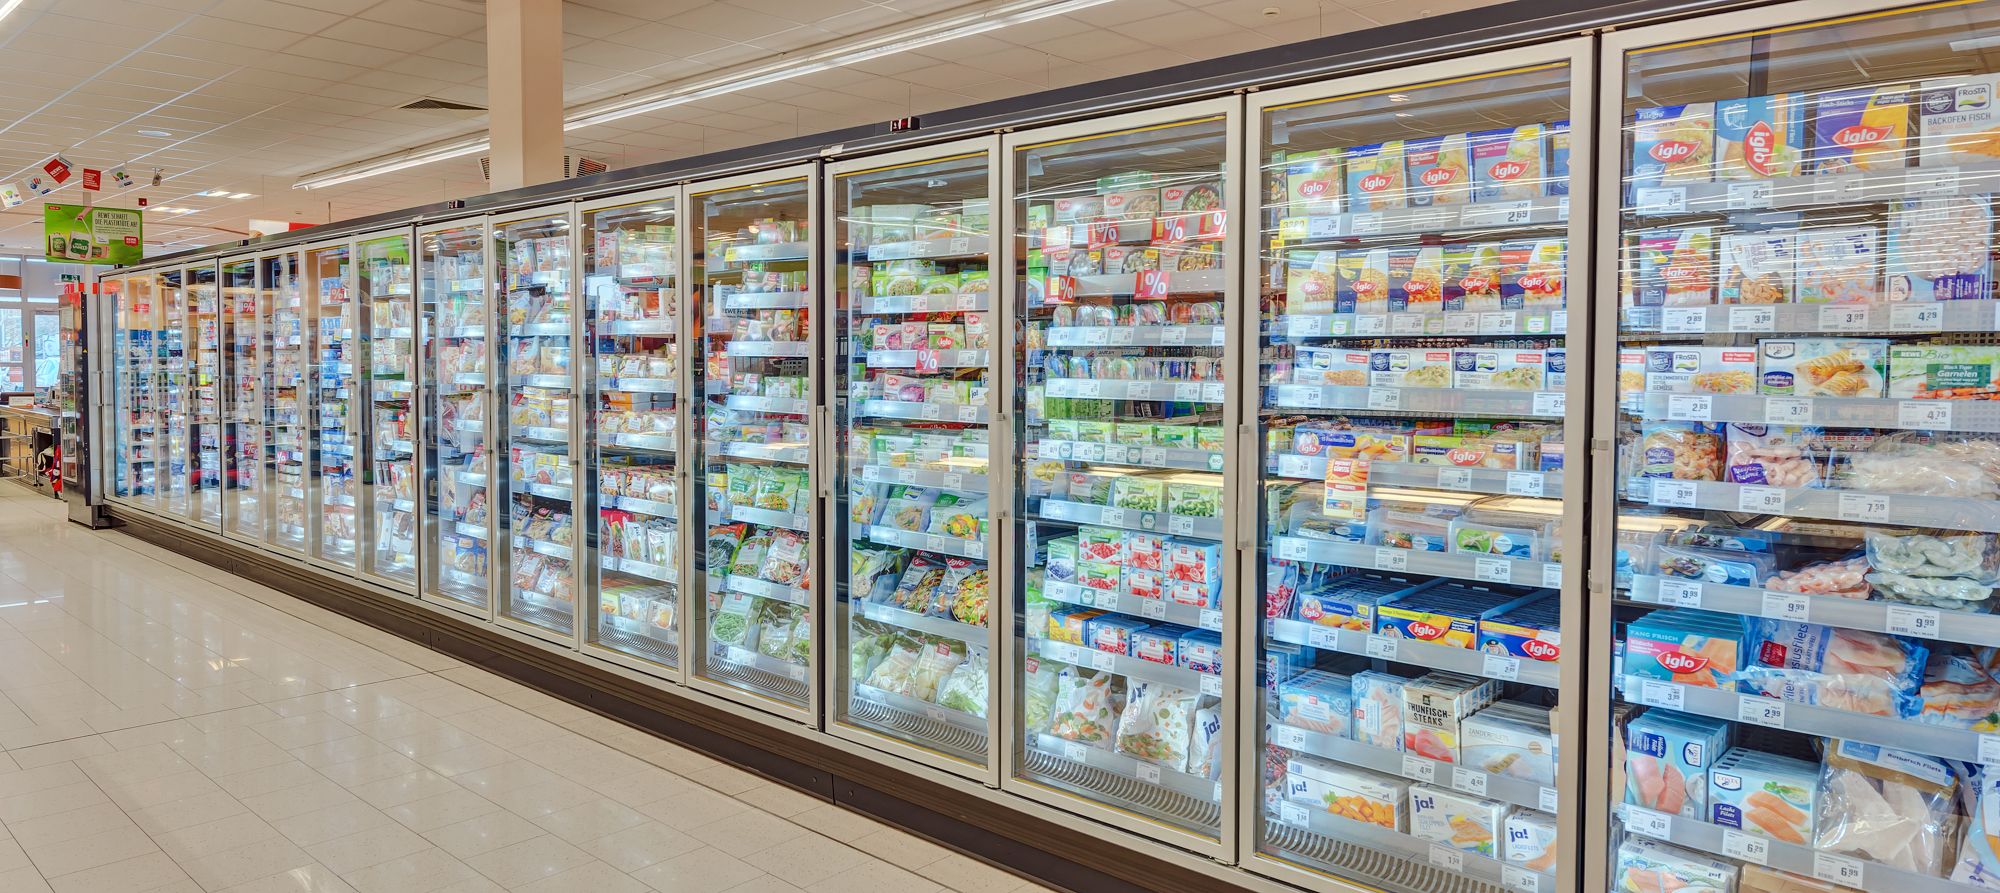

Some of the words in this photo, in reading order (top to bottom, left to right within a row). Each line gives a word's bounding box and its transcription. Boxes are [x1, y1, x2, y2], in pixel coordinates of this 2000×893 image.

[1927, 115, 1966, 126] BACKOFEN
[1968, 112, 1991, 121] FISCH
[1842, 129, 1877, 144] iglo
[1658, 144, 1687, 159] iglo
[1749, 131, 1770, 163] iglo
[1426, 172, 1450, 184] iglo
[1494, 165, 1520, 179] iglo
[1303, 184, 1323, 195] iglo
[1364, 177, 1386, 190] iglo
[1164, 218, 1183, 241] %
[1060, 276, 1073, 300] %
[1145, 272, 1167, 296] %
[1406, 281, 1424, 292] iglo
[1523, 279, 1542, 287] iglo
[940, 338, 952, 347] iglo
[918, 351, 938, 370] %
[1924, 350, 1950, 360] Bio
[1937, 370, 1978, 378] Garnelen
[971, 389, 979, 399] ja!
[1301, 445, 1317, 453] iglo
[1453, 450, 1476, 463] iglo
[948, 558, 967, 567] iglo
[1304, 610, 1320, 618] iglo
[1413, 624, 1436, 637] iglo
[1529, 643, 1556, 656] iglo
[1665, 654, 1695, 669] iglo
[1407, 702, 1452, 718] THUNFISCH-
[1413, 713, 1443, 727] STEAKS
[1202, 714, 1222, 745] ja!
[1291, 781, 1307, 795] ja!
[1413, 795, 1435, 813] ja!
[1509, 827, 1528, 843] ja!
